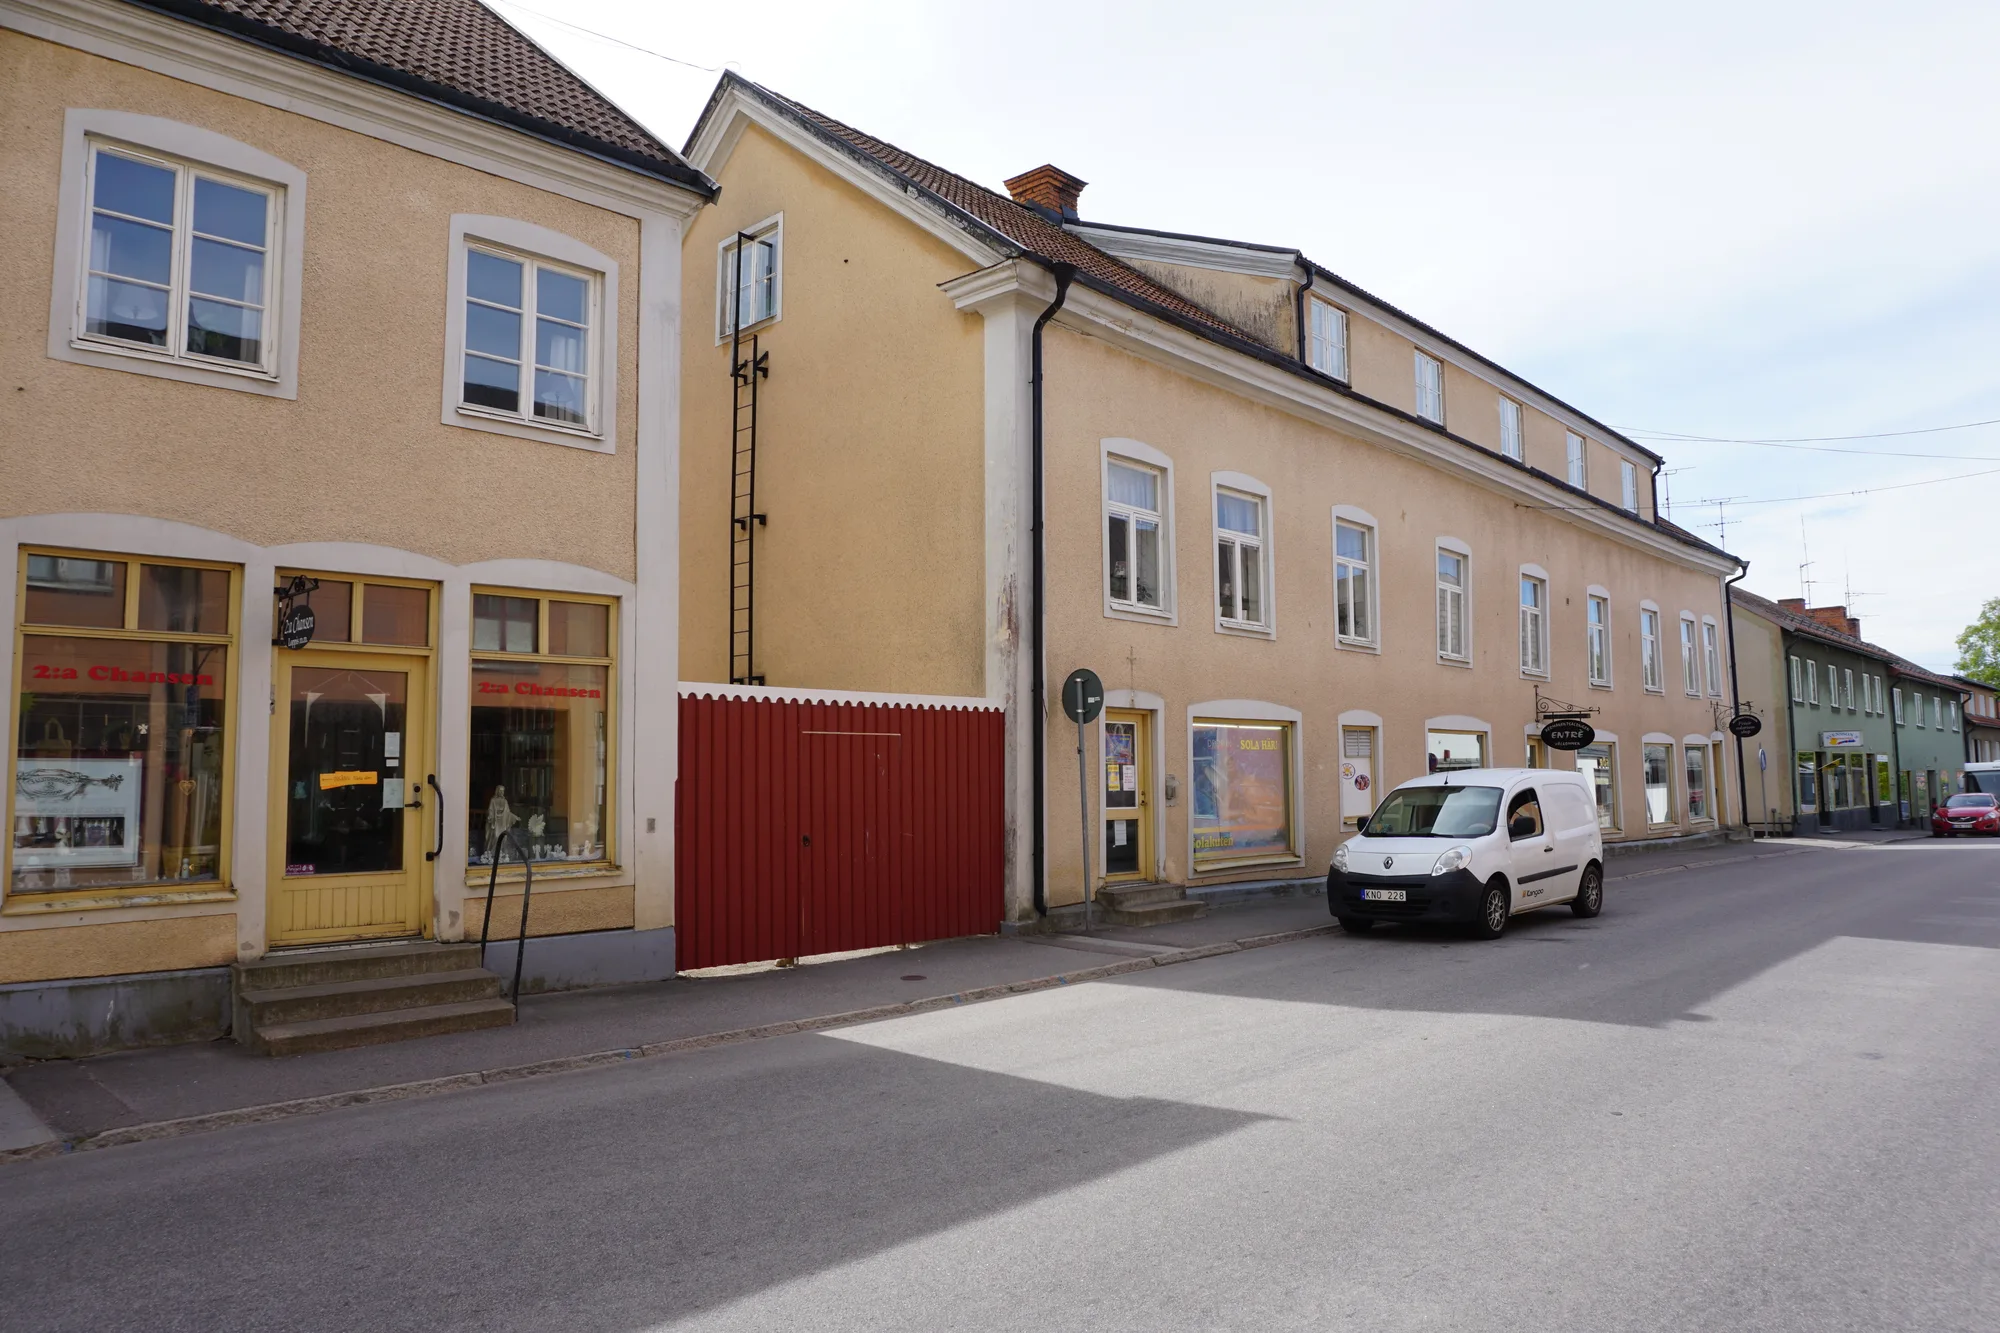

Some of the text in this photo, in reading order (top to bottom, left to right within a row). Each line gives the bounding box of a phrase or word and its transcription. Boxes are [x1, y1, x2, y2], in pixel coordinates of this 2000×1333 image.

[284, 613, 314, 634] 2:a Chansen
[288, 636, 299, 649] Loppis
[33, 665, 213, 686] 2:a Chansen
[479, 682, 600, 699] 2:a Chansen
[1241, 740, 1260, 750] SOLA
[1387, 891, 1405, 900] 228
[1526, 888, 1545, 898] Kangoo
